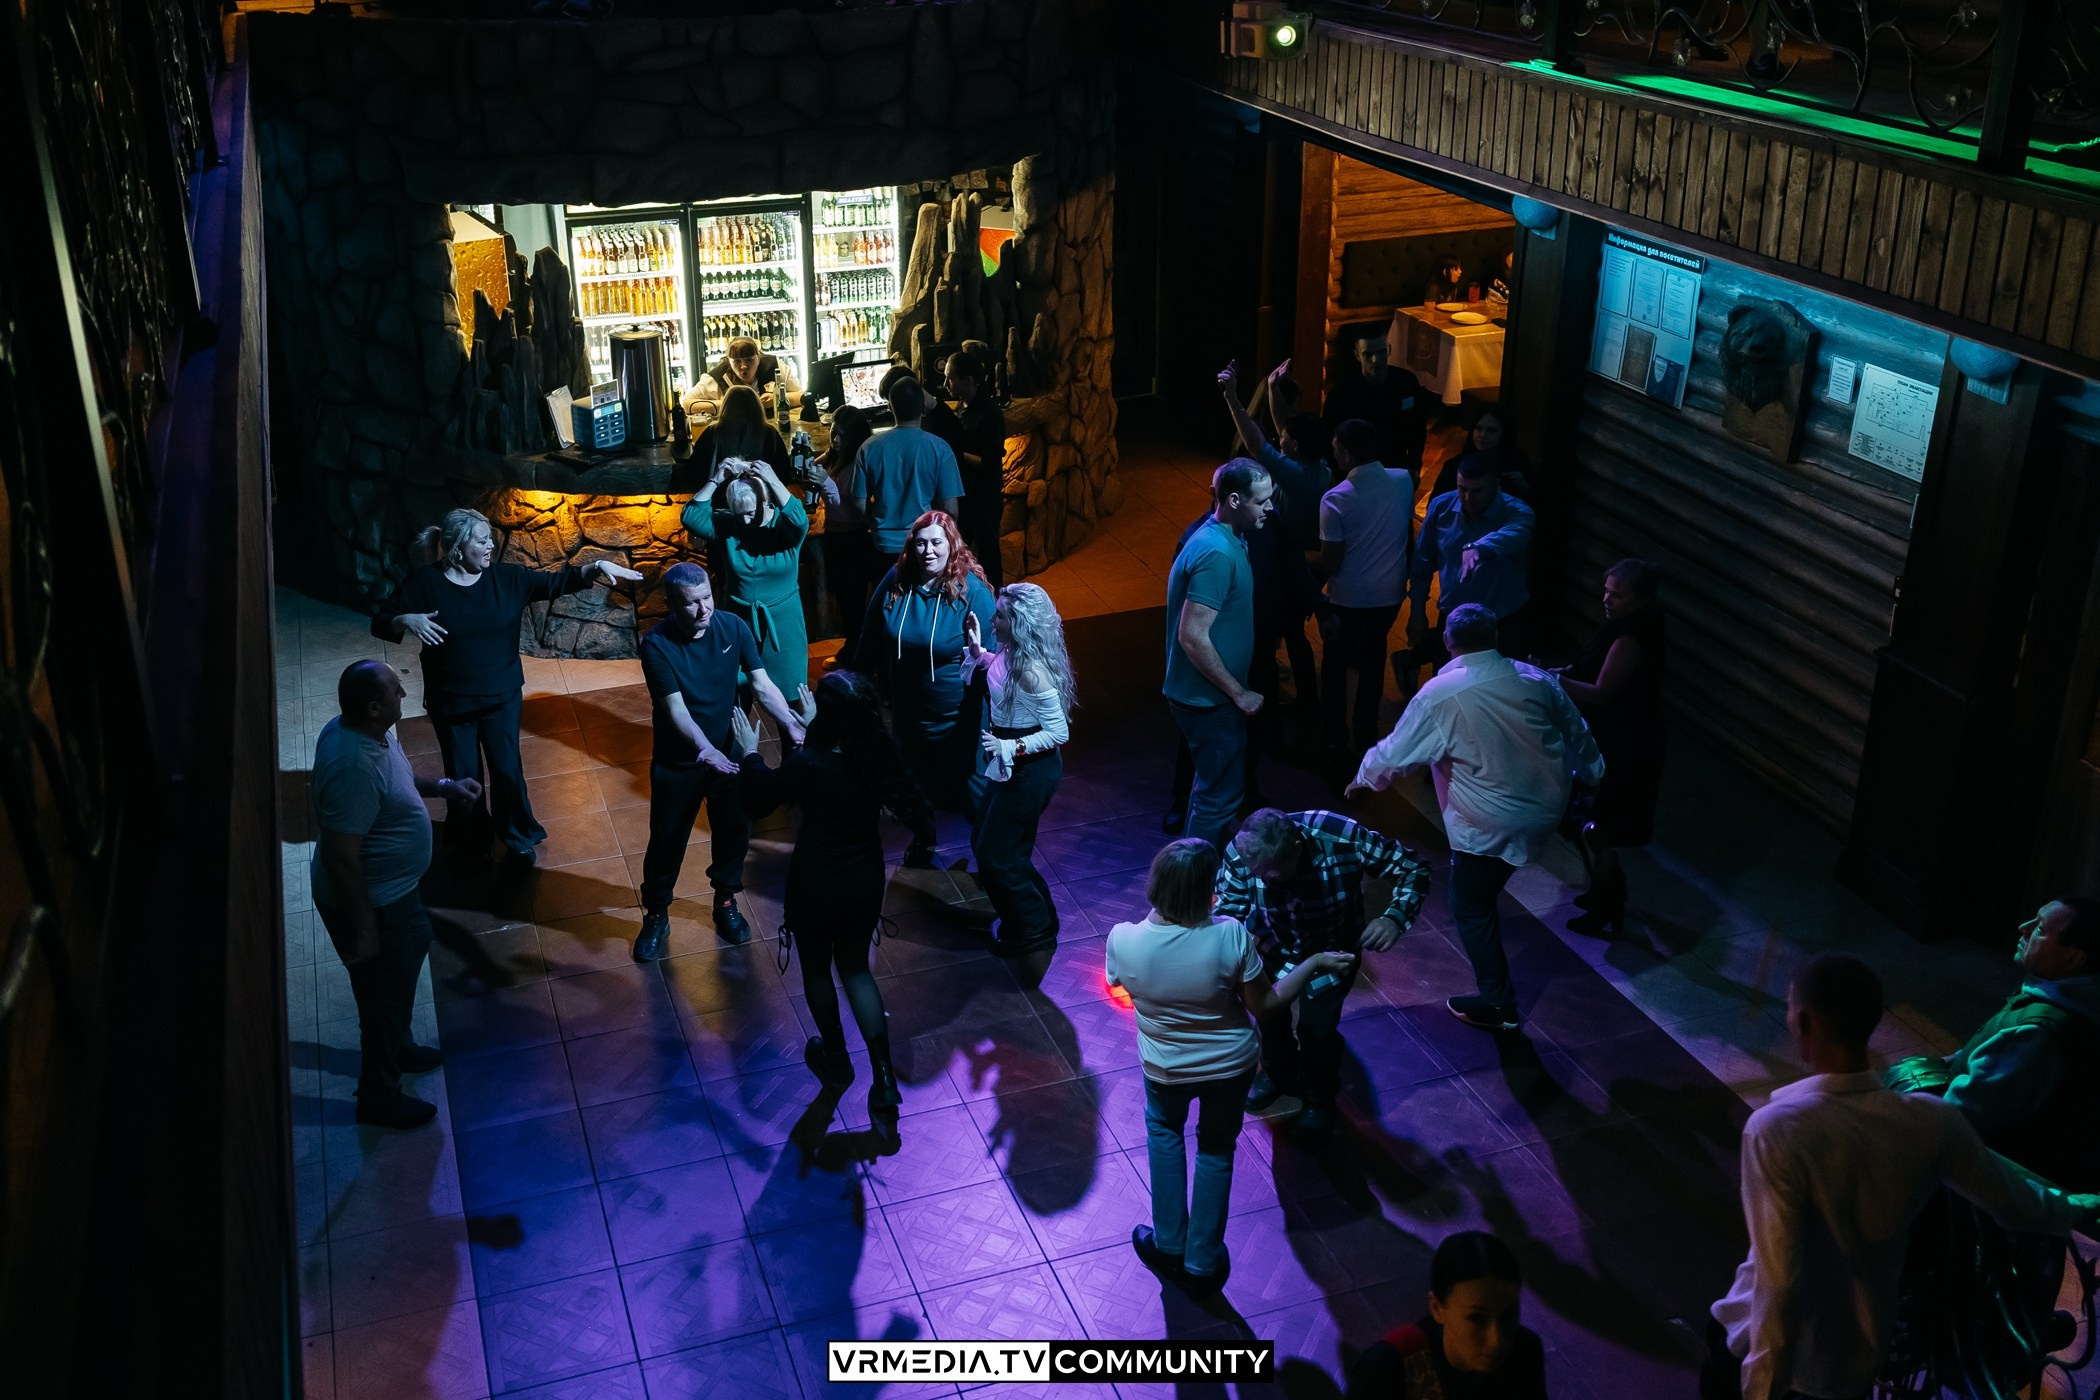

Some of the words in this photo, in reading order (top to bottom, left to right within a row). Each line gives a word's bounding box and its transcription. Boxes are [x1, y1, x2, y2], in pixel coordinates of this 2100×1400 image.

[1608, 233, 1647, 252] Информация
[1647, 247, 1659, 256] для
[1659, 250, 1700, 269] посетителей
